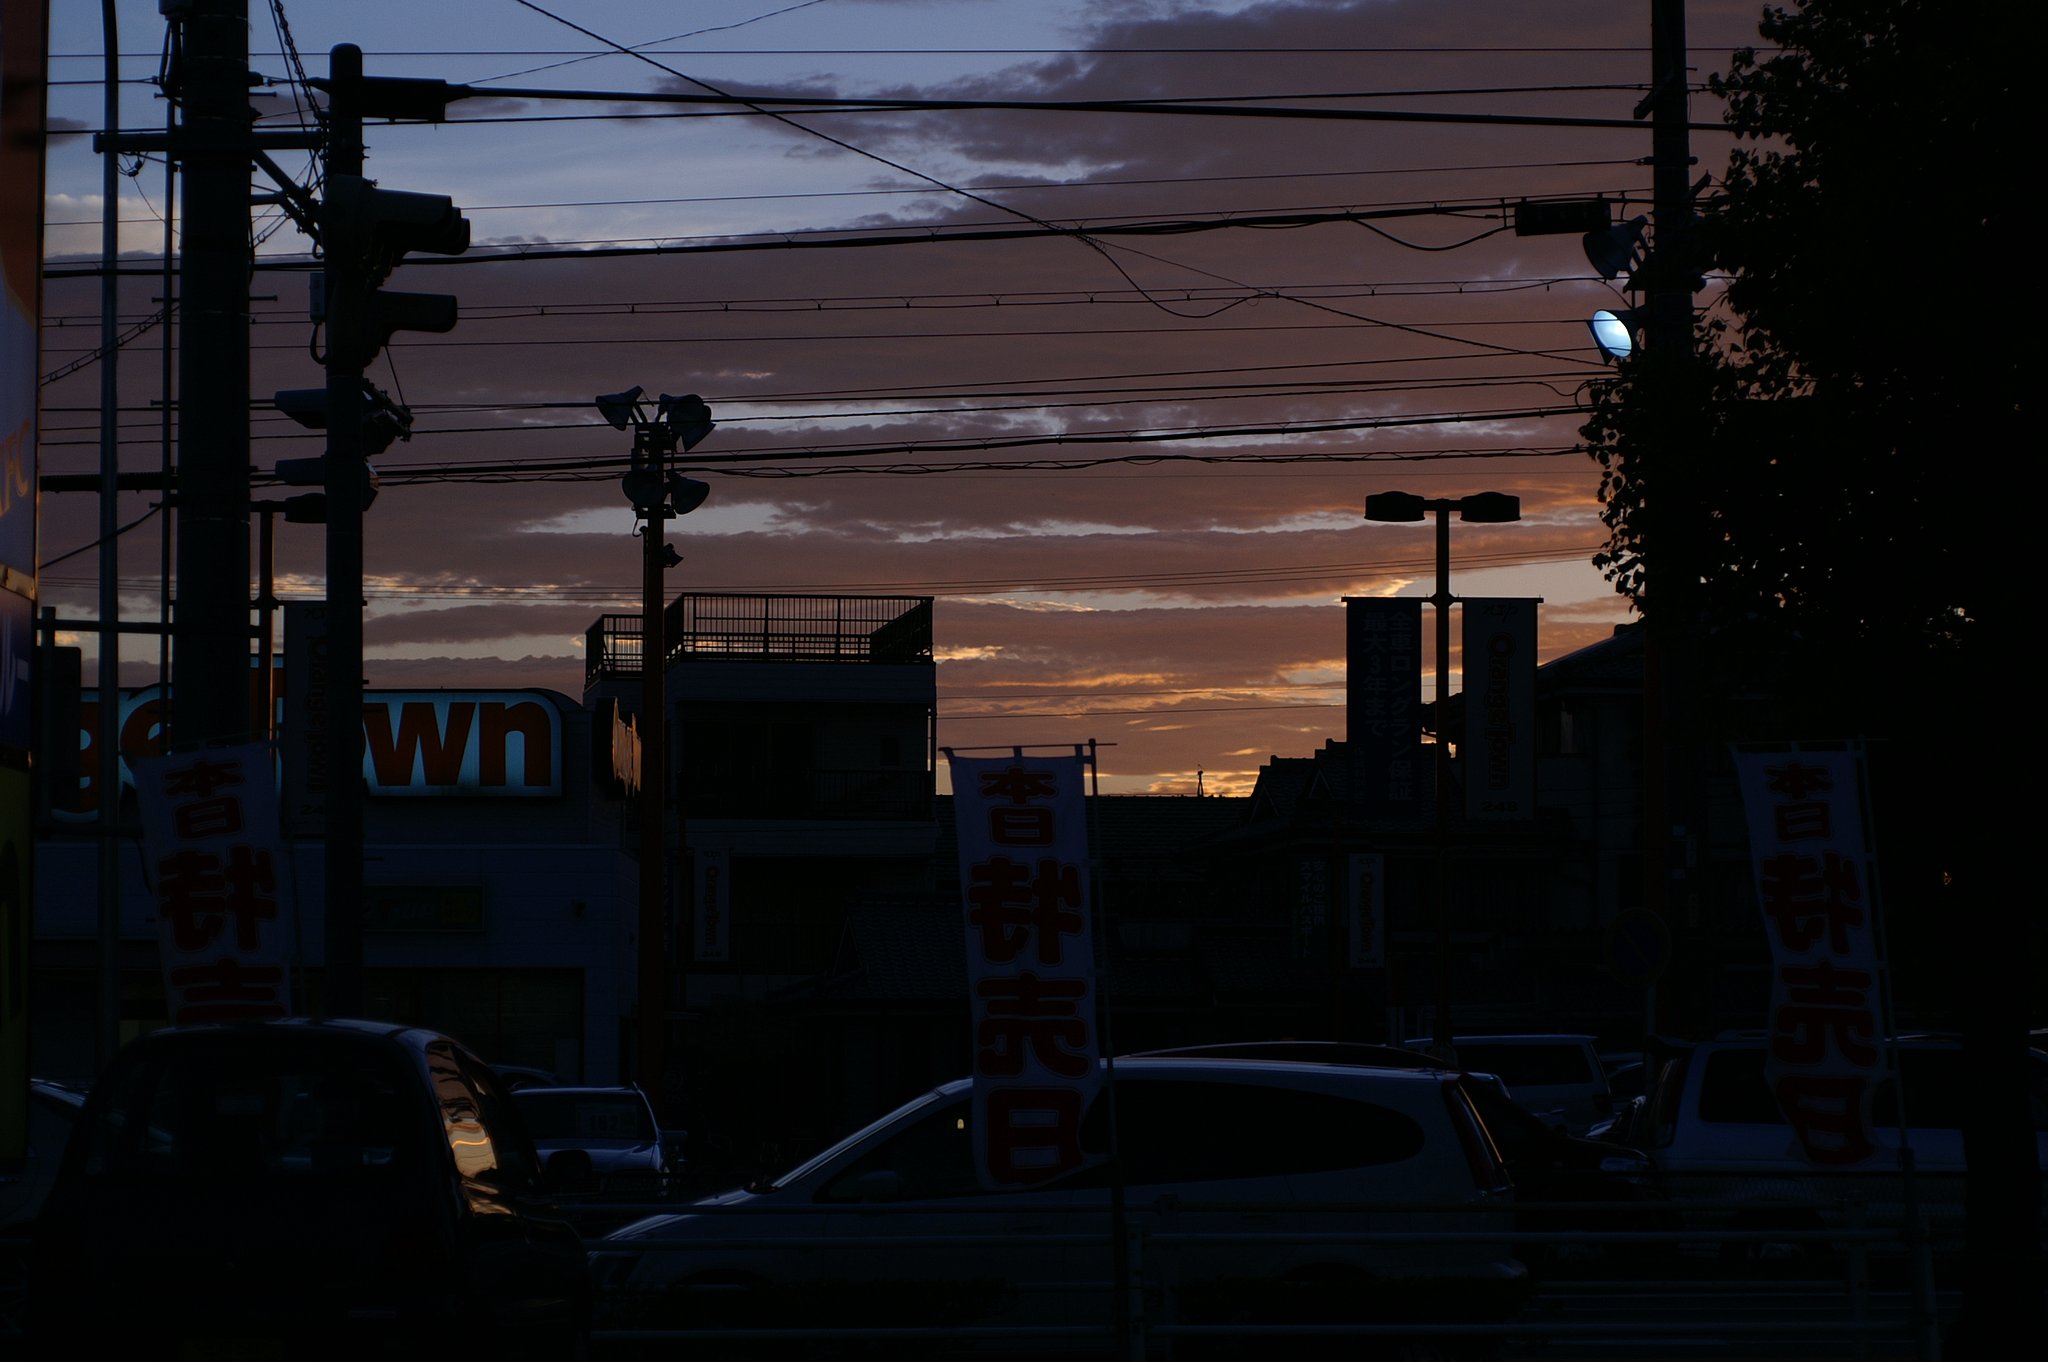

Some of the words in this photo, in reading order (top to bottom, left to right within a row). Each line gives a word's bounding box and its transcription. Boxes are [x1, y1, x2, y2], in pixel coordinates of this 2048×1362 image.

[1361, 611, 1388, 737] 最大3年まで
[1388, 610, 1415, 801] 全車ロングラン保証
